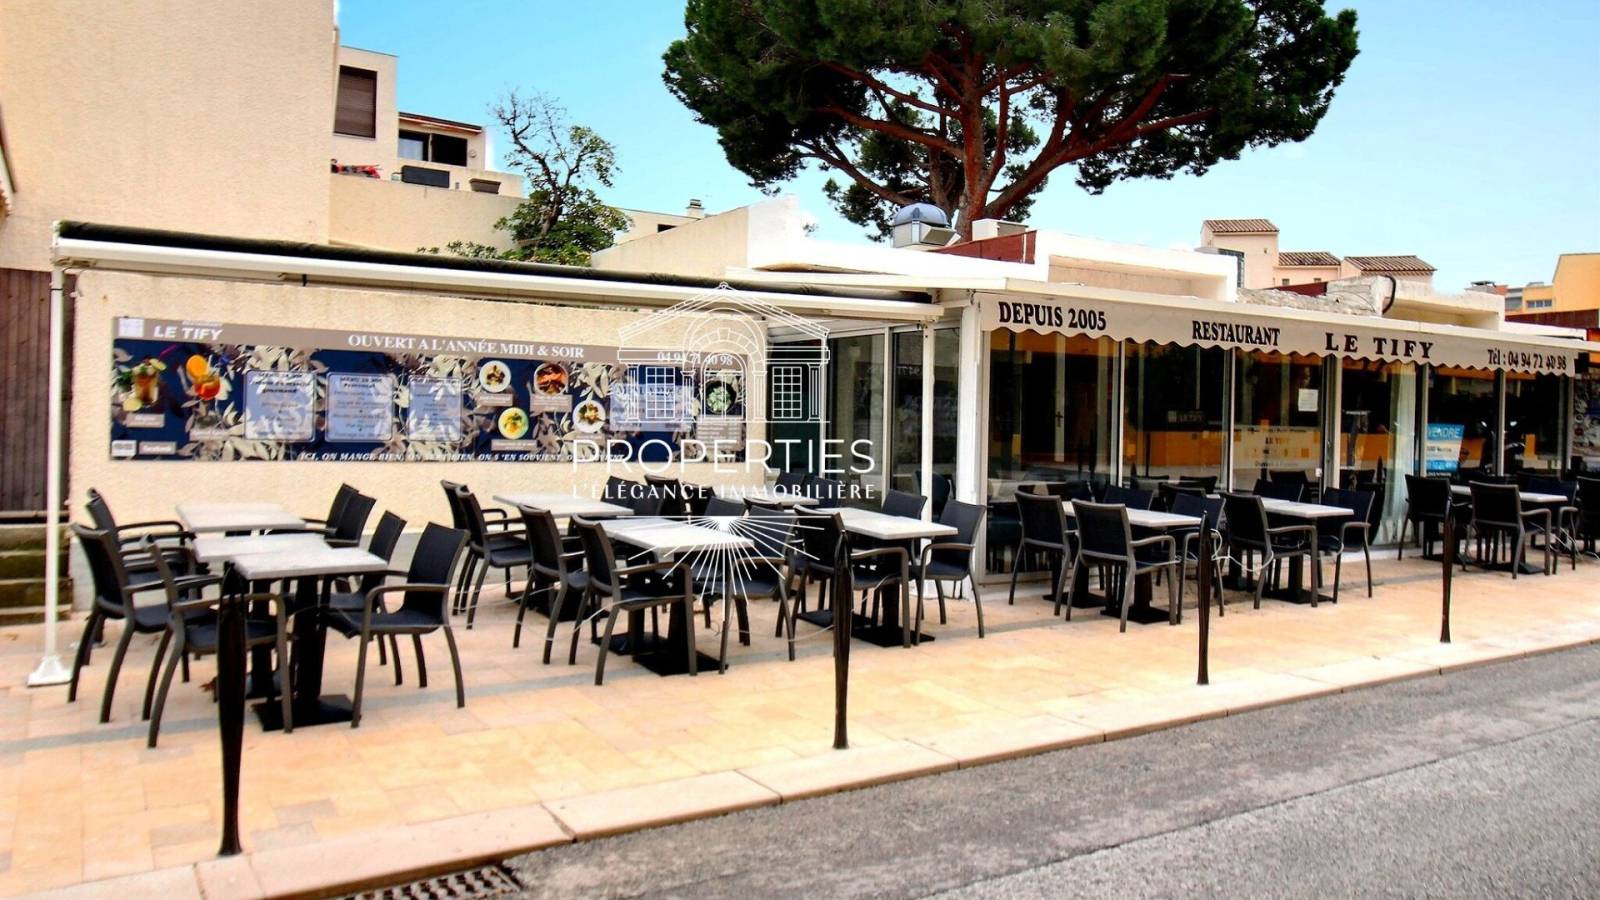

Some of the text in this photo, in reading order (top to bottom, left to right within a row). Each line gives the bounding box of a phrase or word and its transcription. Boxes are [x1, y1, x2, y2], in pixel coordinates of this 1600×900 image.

[998, 301, 1107, 331] DEPUIS 2005
[153, 325, 223, 340] LE TIFY
[1192, 320, 1281, 346] RESTAURANT
[348, 334, 584, 358] OUVERT A L'ANNÉE MIDI & SOIR
[1325, 332, 1434, 359] LE TIFY
[720, 356, 733, 366] 98
[1508, 351, 1519, 366] 04
[1521, 353, 1531, 368] 94
[322, 453, 337, 461] ON
[340, 453, 374, 461] MANGE
[478, 453, 491, 461] ON
